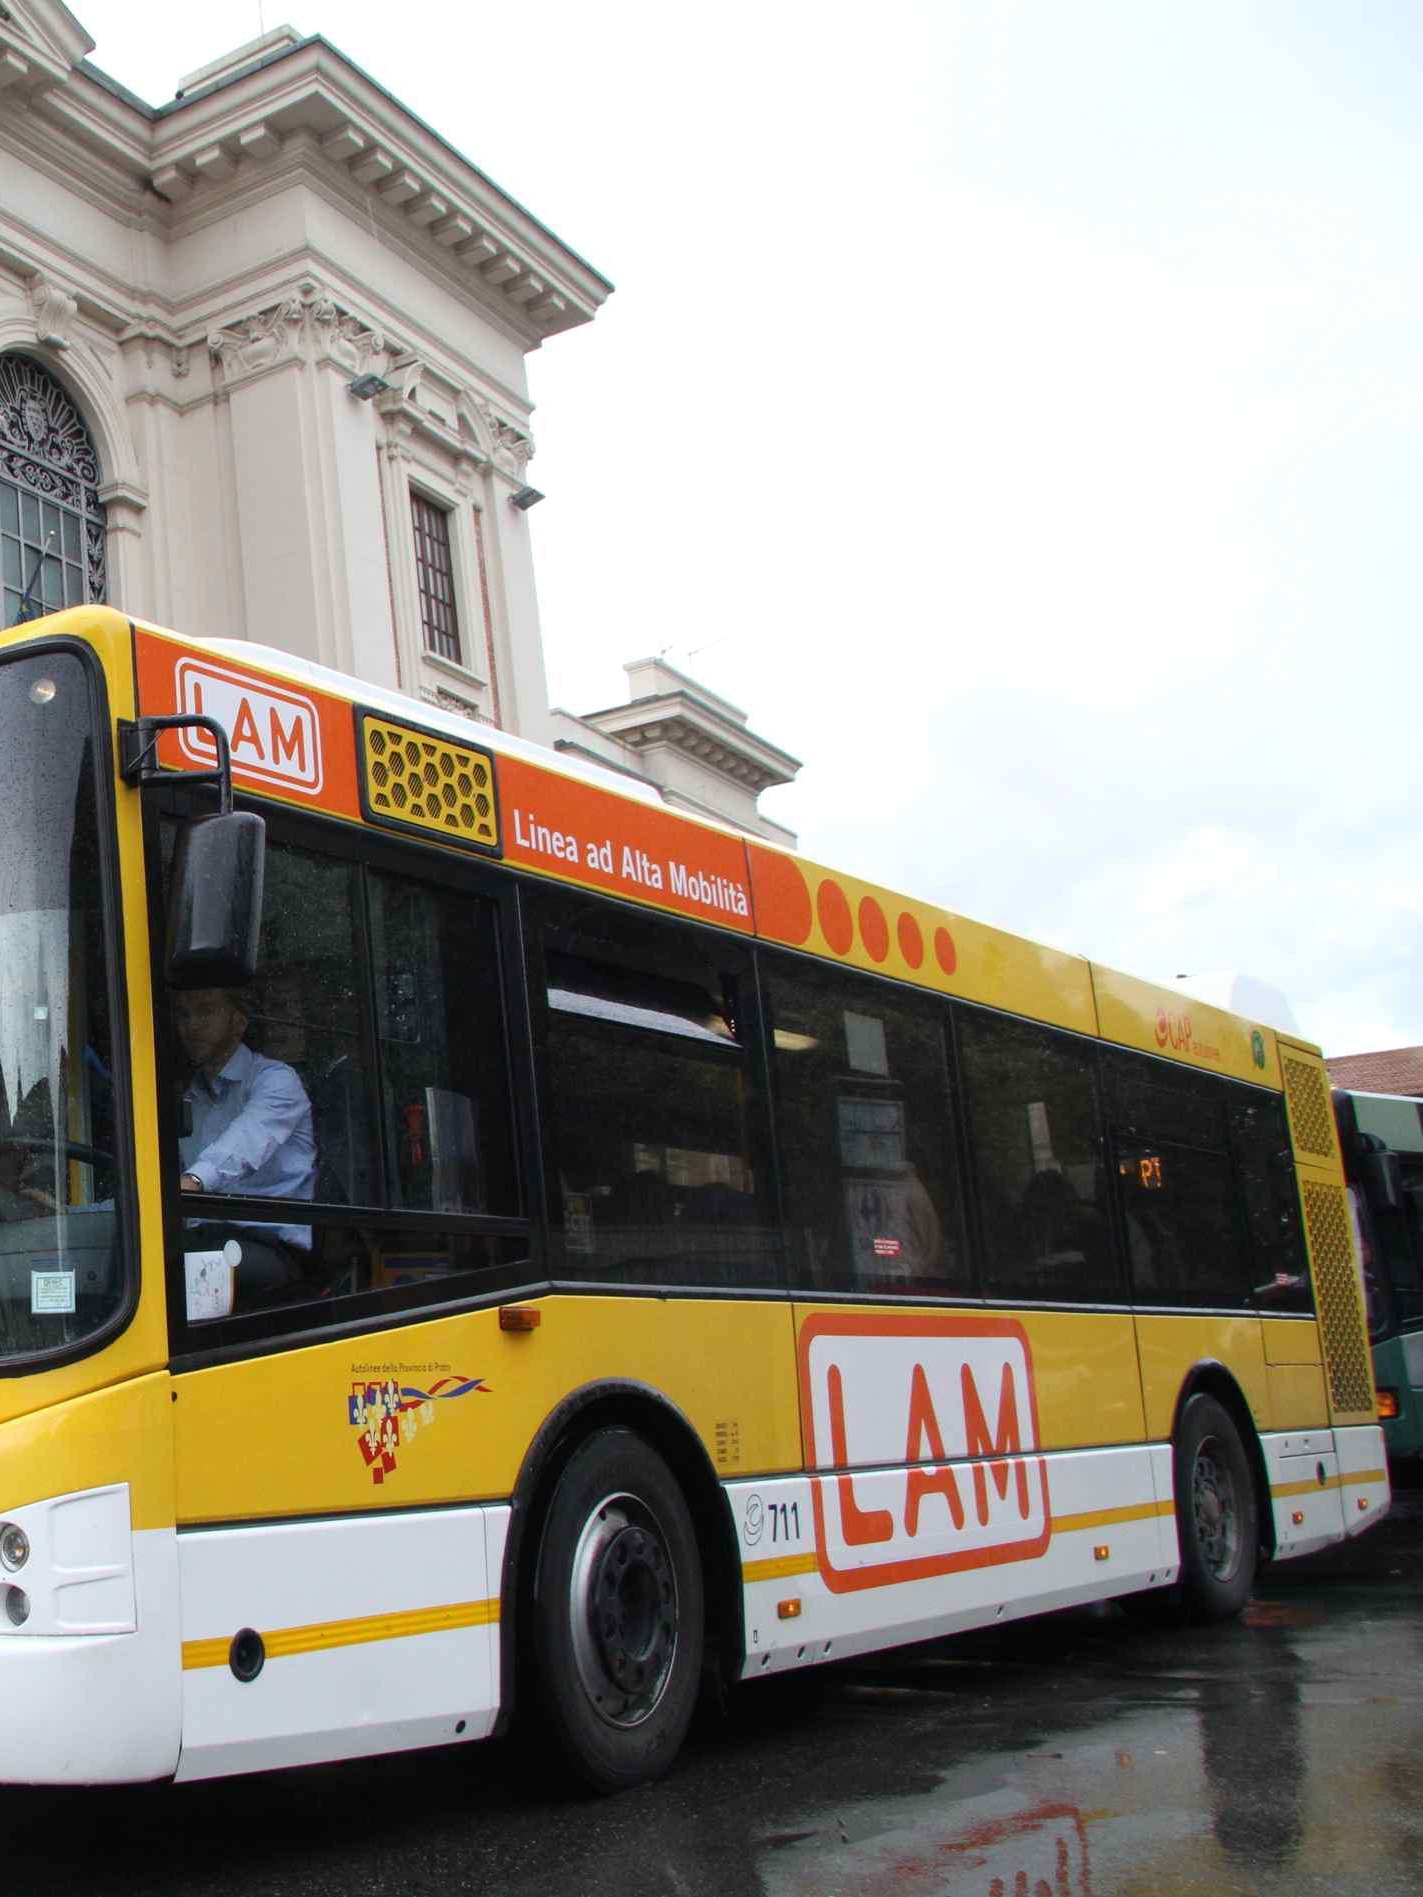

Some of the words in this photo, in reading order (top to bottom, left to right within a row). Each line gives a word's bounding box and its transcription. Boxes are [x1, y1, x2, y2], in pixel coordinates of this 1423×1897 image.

[513, 808, 579, 864] Linea
[585, 839, 614, 875] ad
[621, 845, 664, 890] Alta
[668, 860, 750, 917] Mobilità
[827, 1361, 1030, 1547] LAM
[767, 1500, 801, 1543] 711
